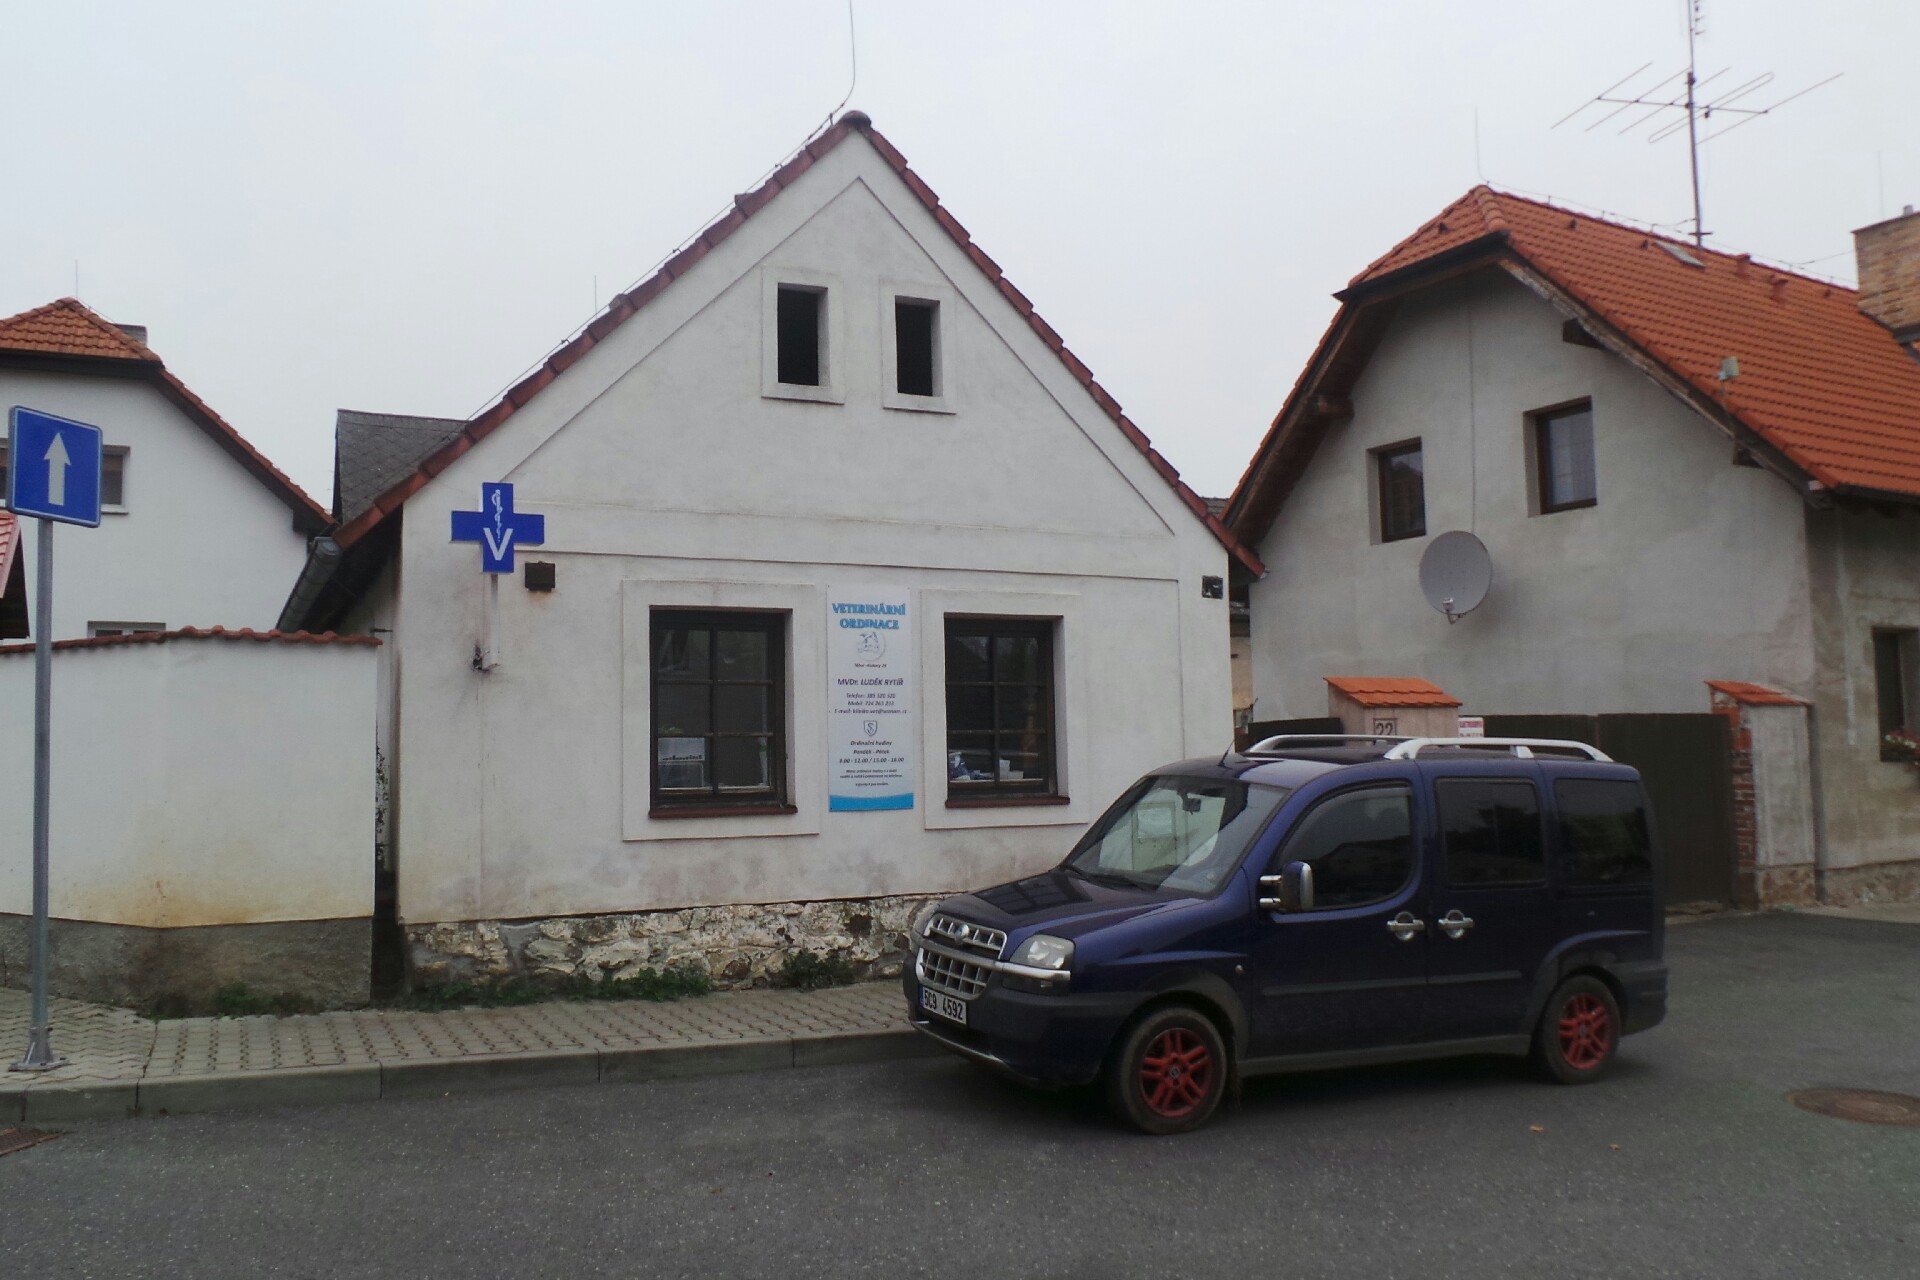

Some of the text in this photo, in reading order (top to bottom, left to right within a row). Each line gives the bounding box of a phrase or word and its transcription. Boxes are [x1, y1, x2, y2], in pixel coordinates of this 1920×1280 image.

[483, 527, 514, 561] V
[832, 602, 906, 616] VETERINÁRNÍ
[839, 618, 900, 630] ORDINACE
[860, 677, 883, 686] LUDĚK
[1375, 722, 1394, 736] 22
[924, 989, 964, 1021] 5C9 4592
